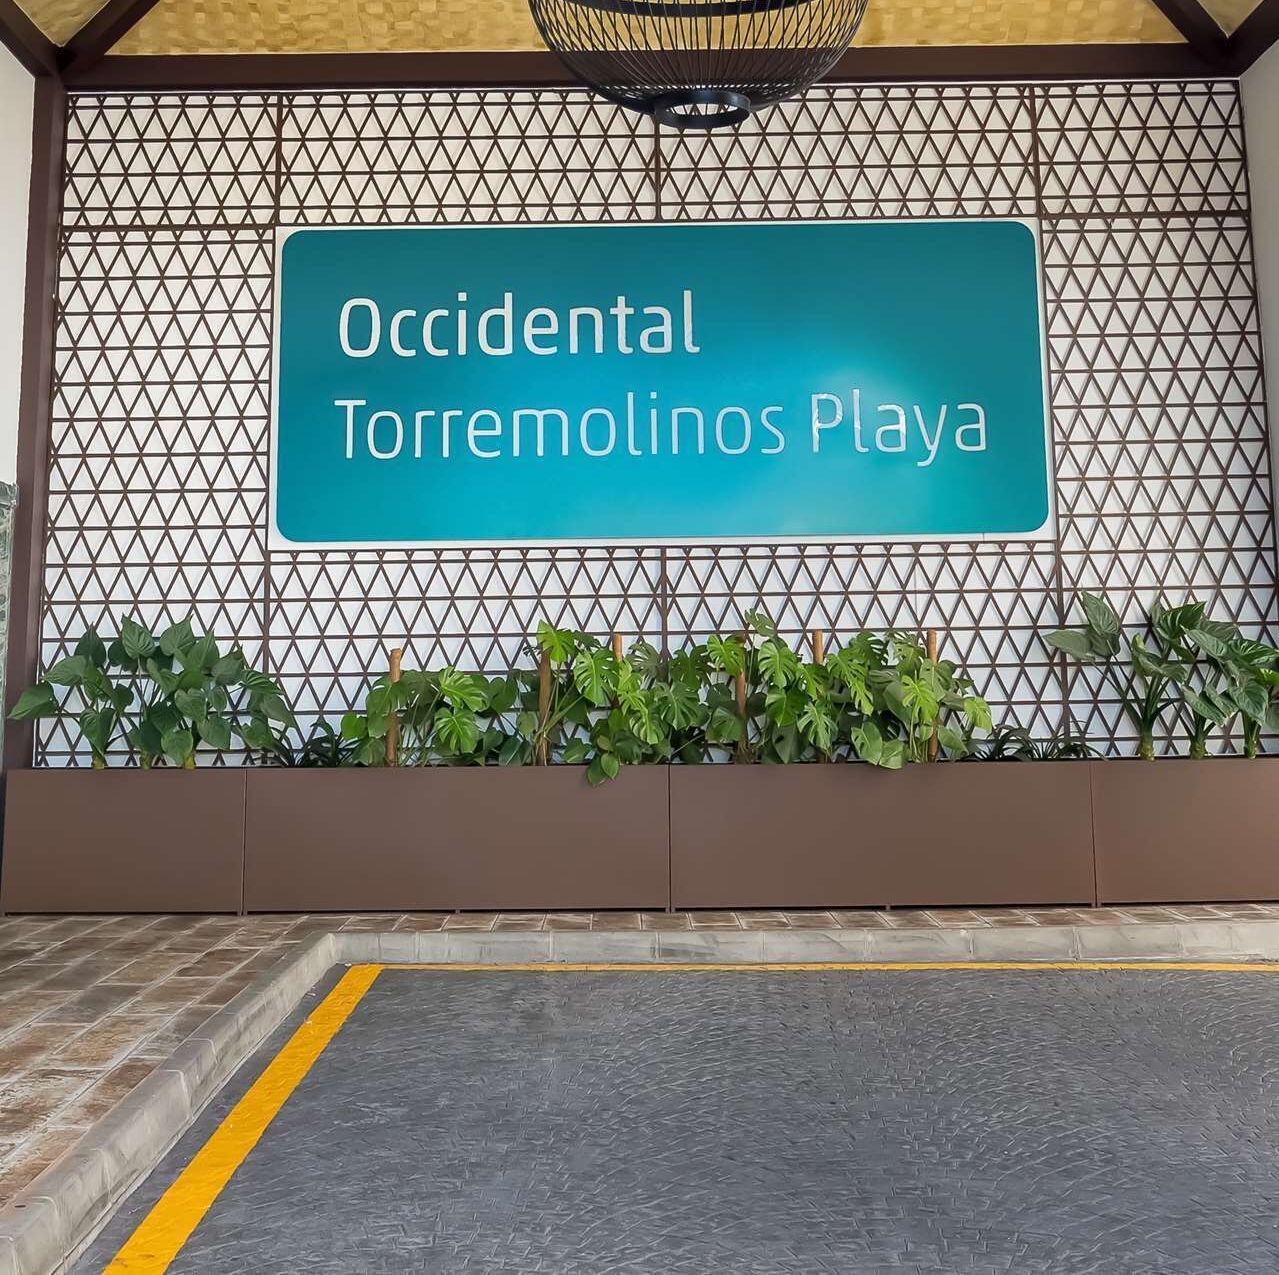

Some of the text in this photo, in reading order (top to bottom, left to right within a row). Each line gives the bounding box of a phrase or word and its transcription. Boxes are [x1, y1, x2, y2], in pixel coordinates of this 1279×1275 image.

[338, 289, 701, 358] Occidental
[333, 388, 988, 468] Torremolinos Playa
